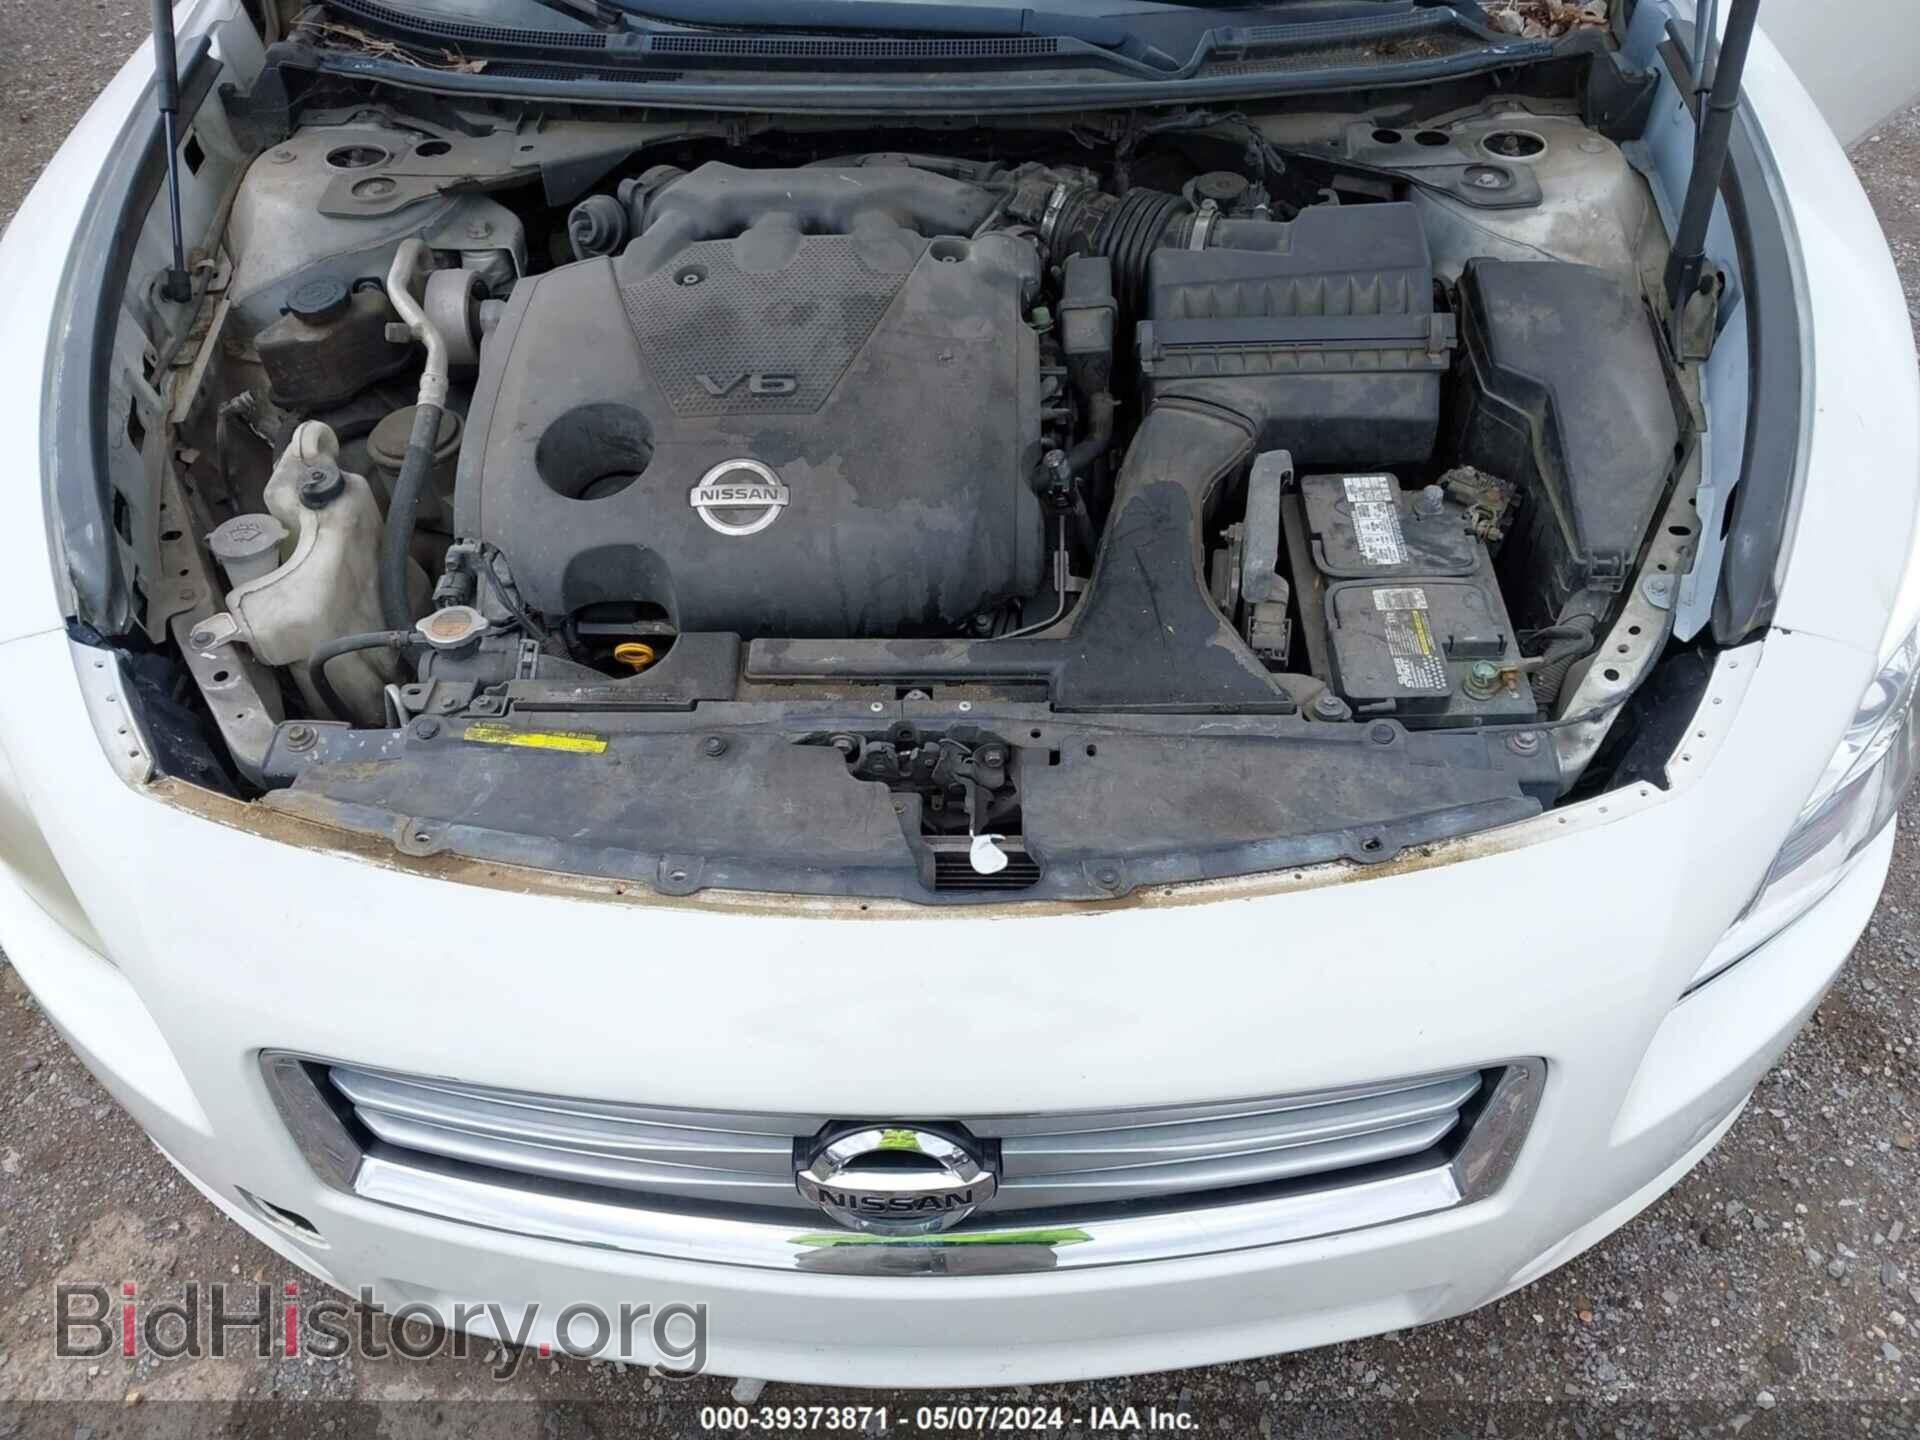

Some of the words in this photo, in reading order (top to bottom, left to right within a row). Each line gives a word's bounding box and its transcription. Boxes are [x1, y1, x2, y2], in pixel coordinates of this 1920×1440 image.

[695, 373, 796, 397] V6
[700, 488, 778, 501] NISSAN
[819, 1189, 973, 1212] NISSAN
